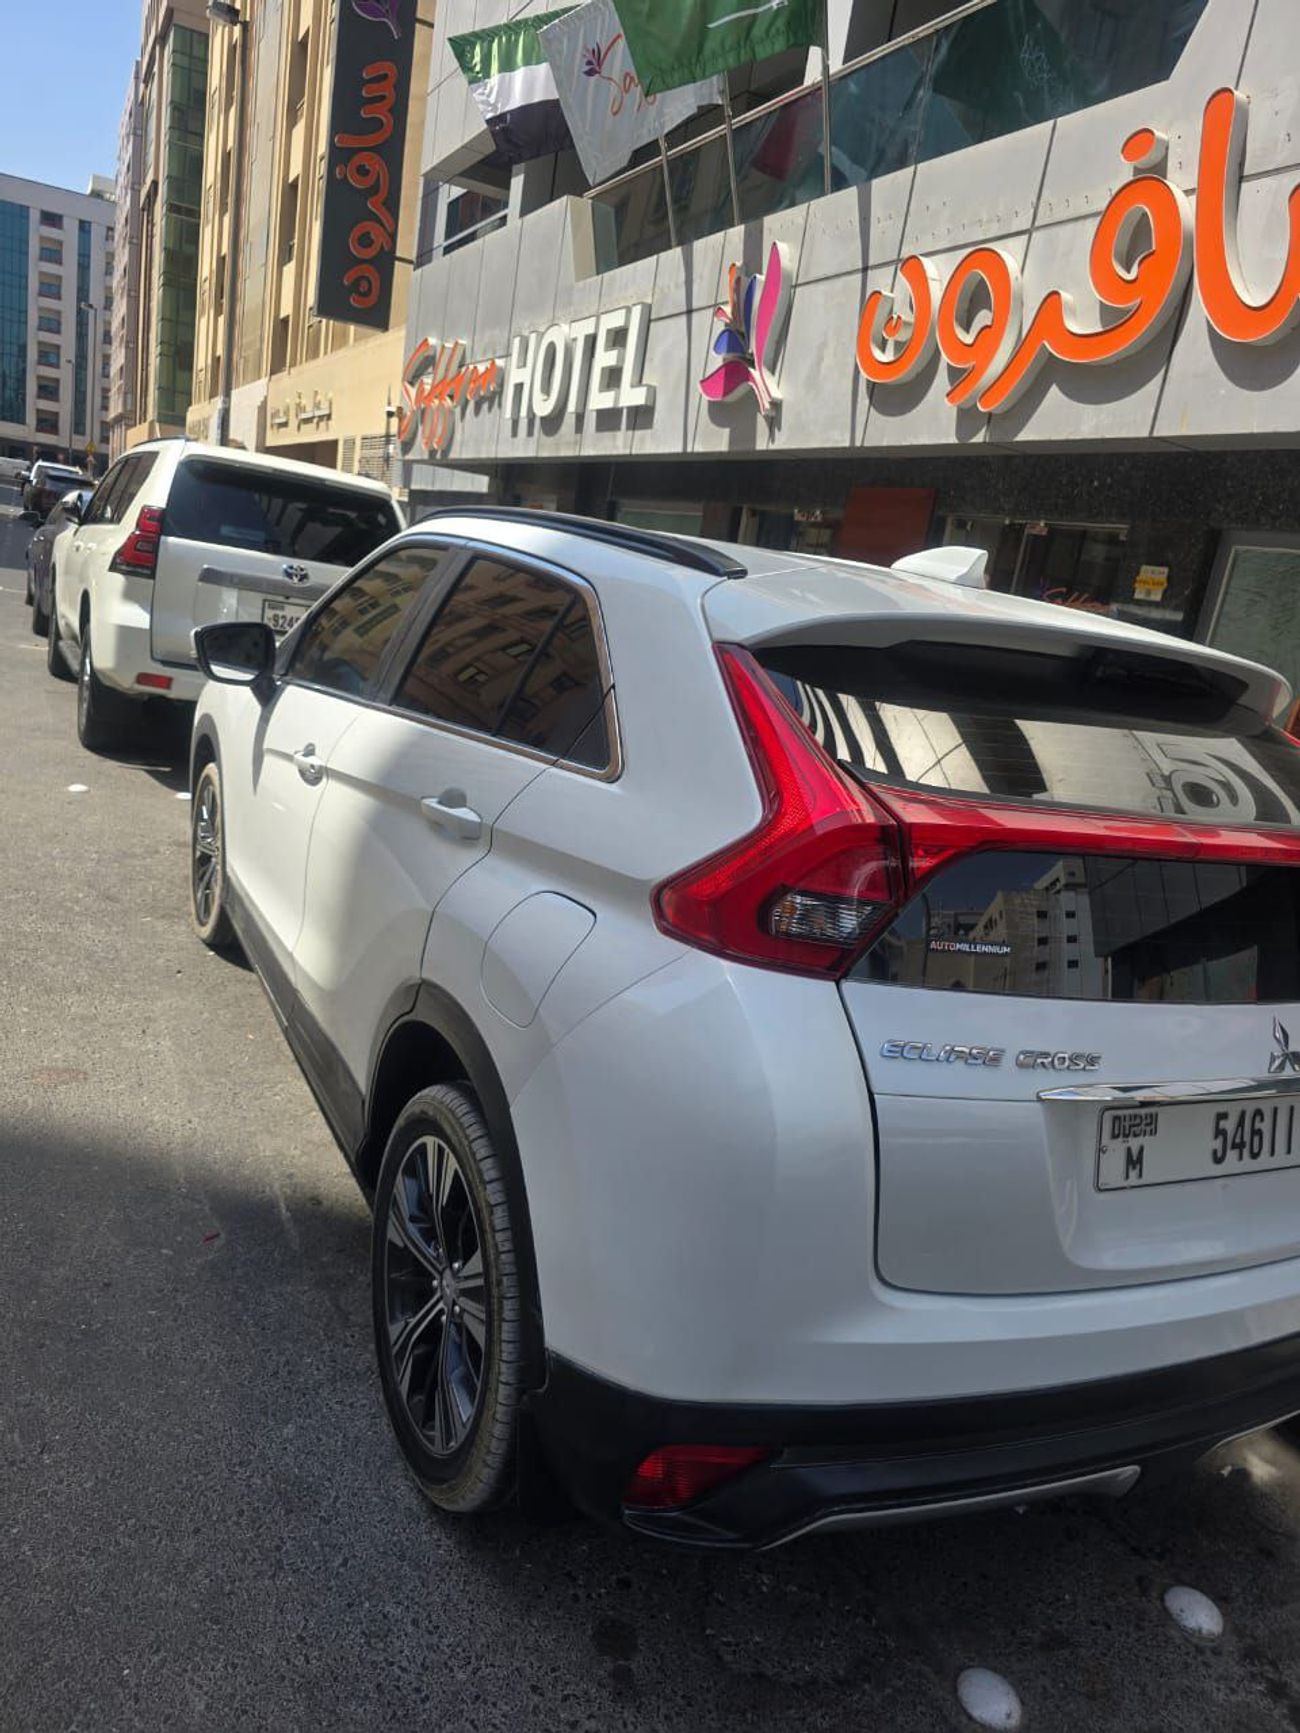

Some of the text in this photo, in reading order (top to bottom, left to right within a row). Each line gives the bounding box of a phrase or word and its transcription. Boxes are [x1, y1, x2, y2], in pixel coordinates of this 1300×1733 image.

[856, 86, 1300, 413] افرون
[505, 303, 656, 420] HOTEL
[880, 1039, 1102, 1071] ECLIPSE CROSS
[1124, 1145, 1145, 1181] M
[1213, 1104, 1294, 1165] 54611
